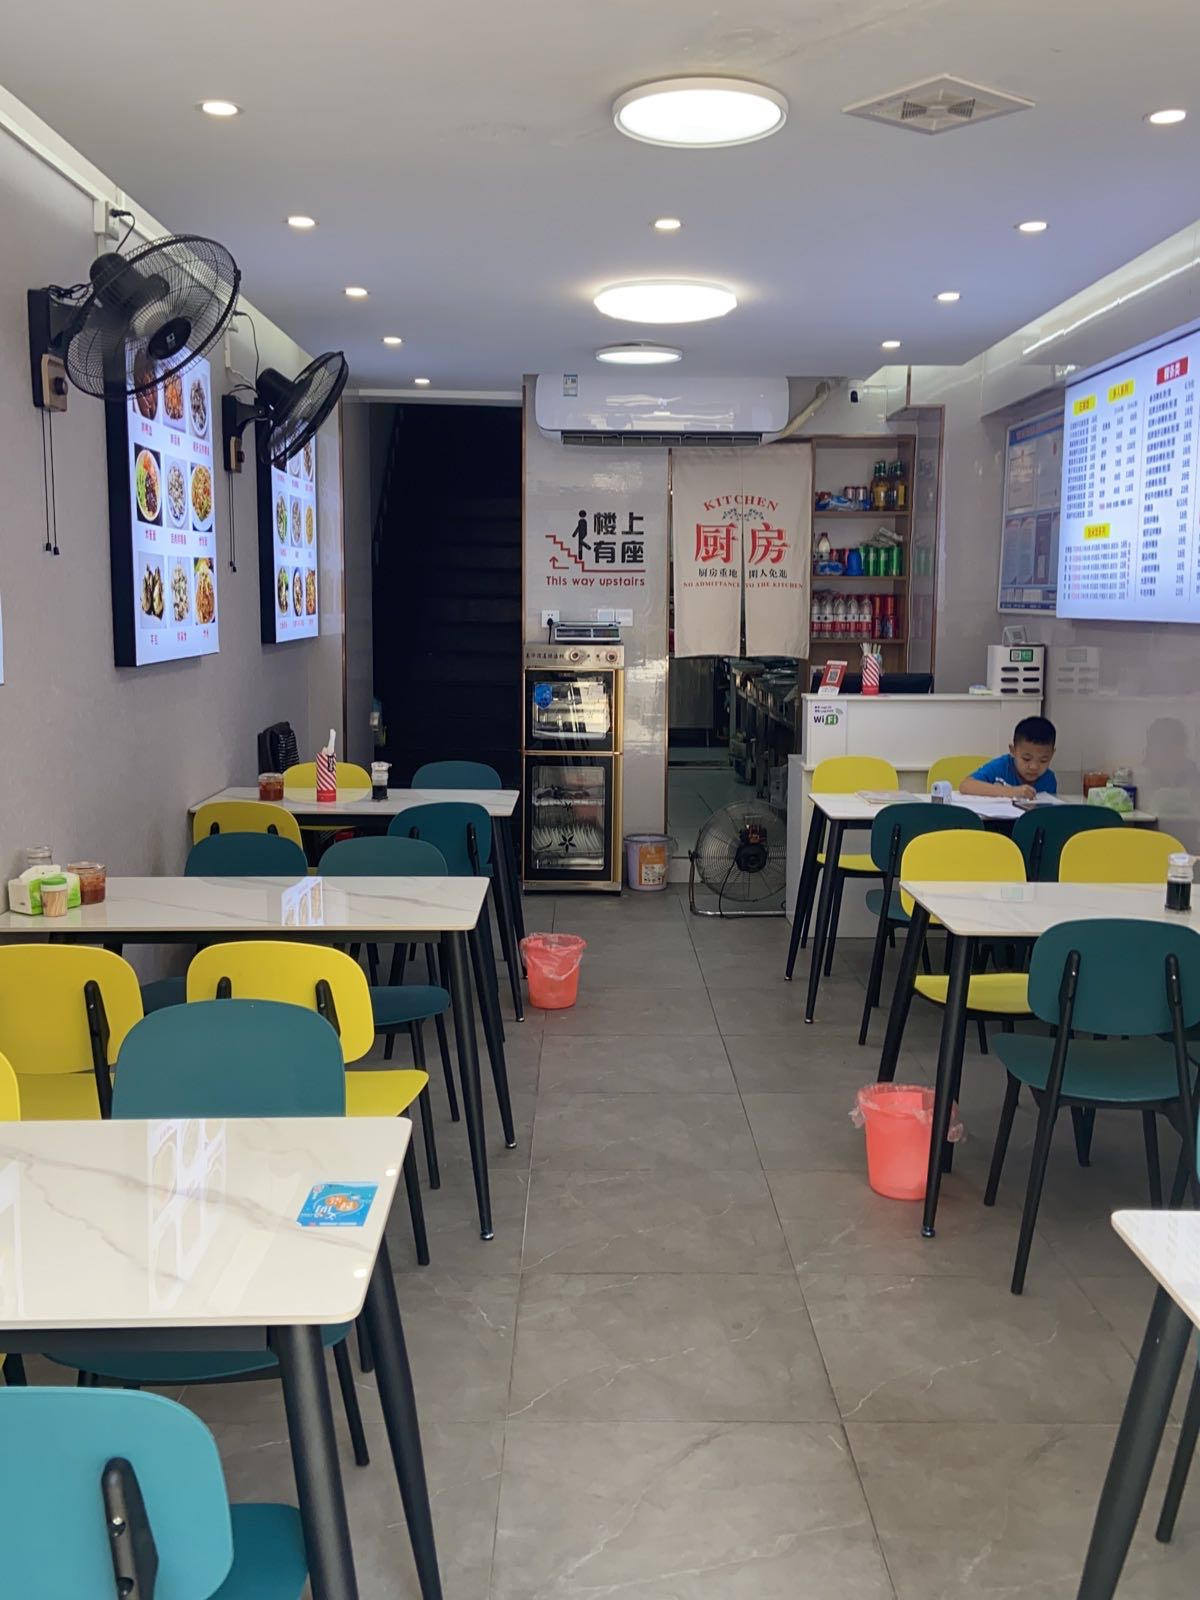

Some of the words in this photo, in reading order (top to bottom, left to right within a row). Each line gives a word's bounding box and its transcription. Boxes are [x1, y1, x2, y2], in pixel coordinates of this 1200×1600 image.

[703, 494, 780, 512] KITCHEN
[593, 511, 644, 535] 楼上
[593, 540, 644, 563] 有座
[694, 522, 791, 565] 厨房
[546, 576, 567, 586] This
[572, 577, 594, 587] way
[599, 576, 645, 587] upstairs
[698, 567, 738, 578] 厨房重地
[813, 714, 838, 725] WiFi
